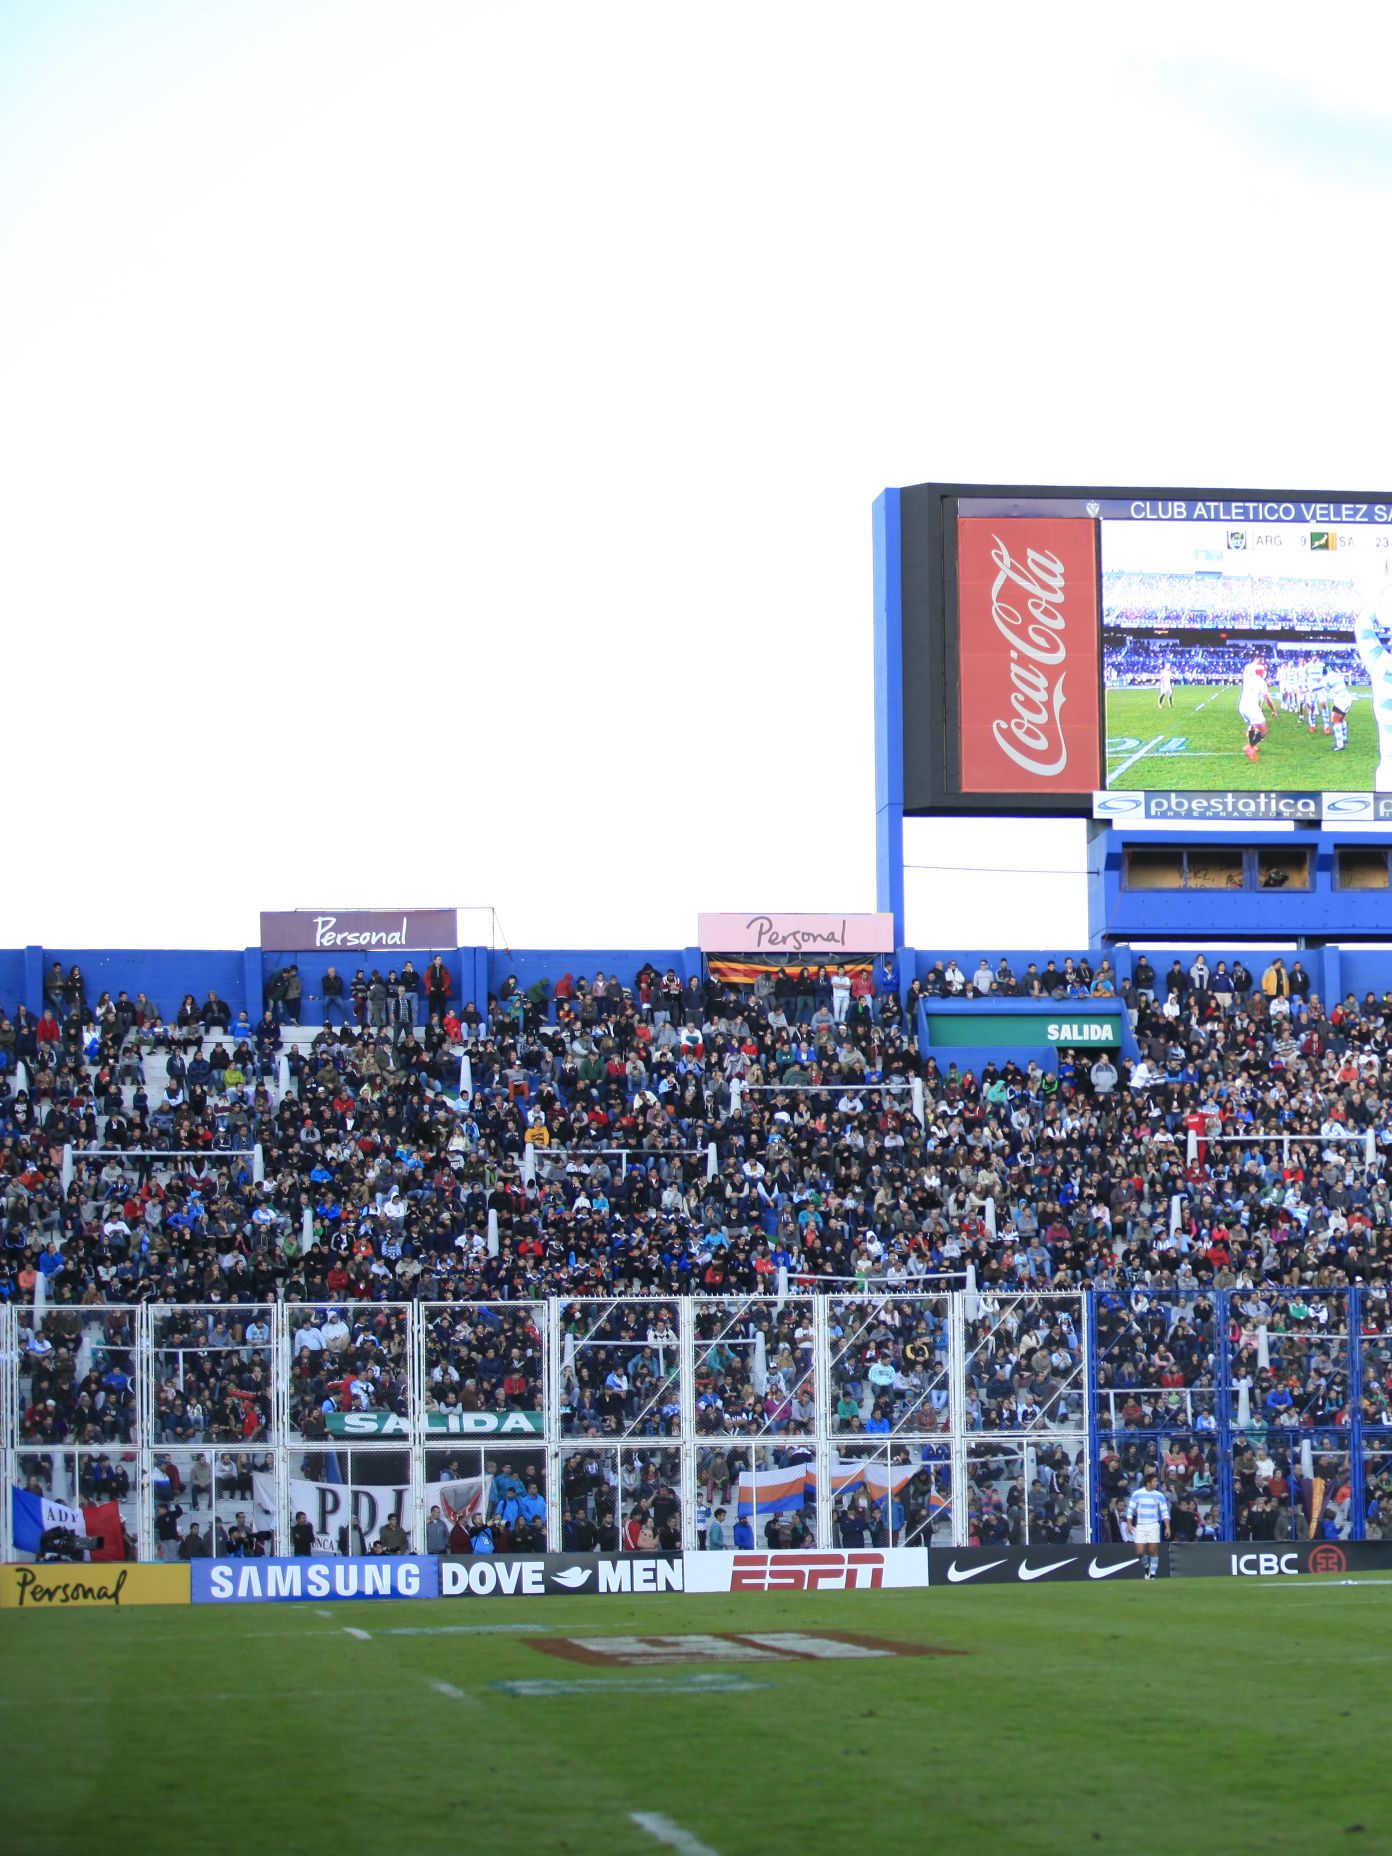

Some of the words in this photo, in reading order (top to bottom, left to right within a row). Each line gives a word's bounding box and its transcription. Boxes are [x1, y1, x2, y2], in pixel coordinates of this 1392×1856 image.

[1130, 501, 1187, 519] CLUB
[1194, 502, 1296, 520] ATLETICO
[1301, 504, 1369, 521] VELEZ
[1256, 535, 1283, 546] ARG
[1339, 537, 1355, 547] SA
[1375, 537, 1389, 548] 23
[991, 533, 1067, 776] Coca-Cola
[1150, 794, 1316, 816] pbestatica
[313, 916, 408, 947] Personal
[746, 916, 847, 952] Personal
[1047, 1024, 1114, 1041] SALIDA
[344, 1414, 536, 1434] SALIDA
[442, 1561, 545, 1595] DOVE
[599, 1559, 683, 1592] MEN
[729, 1553, 885, 1591] ESPN
[1231, 1553, 1298, 1576] ICBC
[15, 1567, 128, 1606] Personal
[211, 1564, 421, 1599] SAMSUNG
